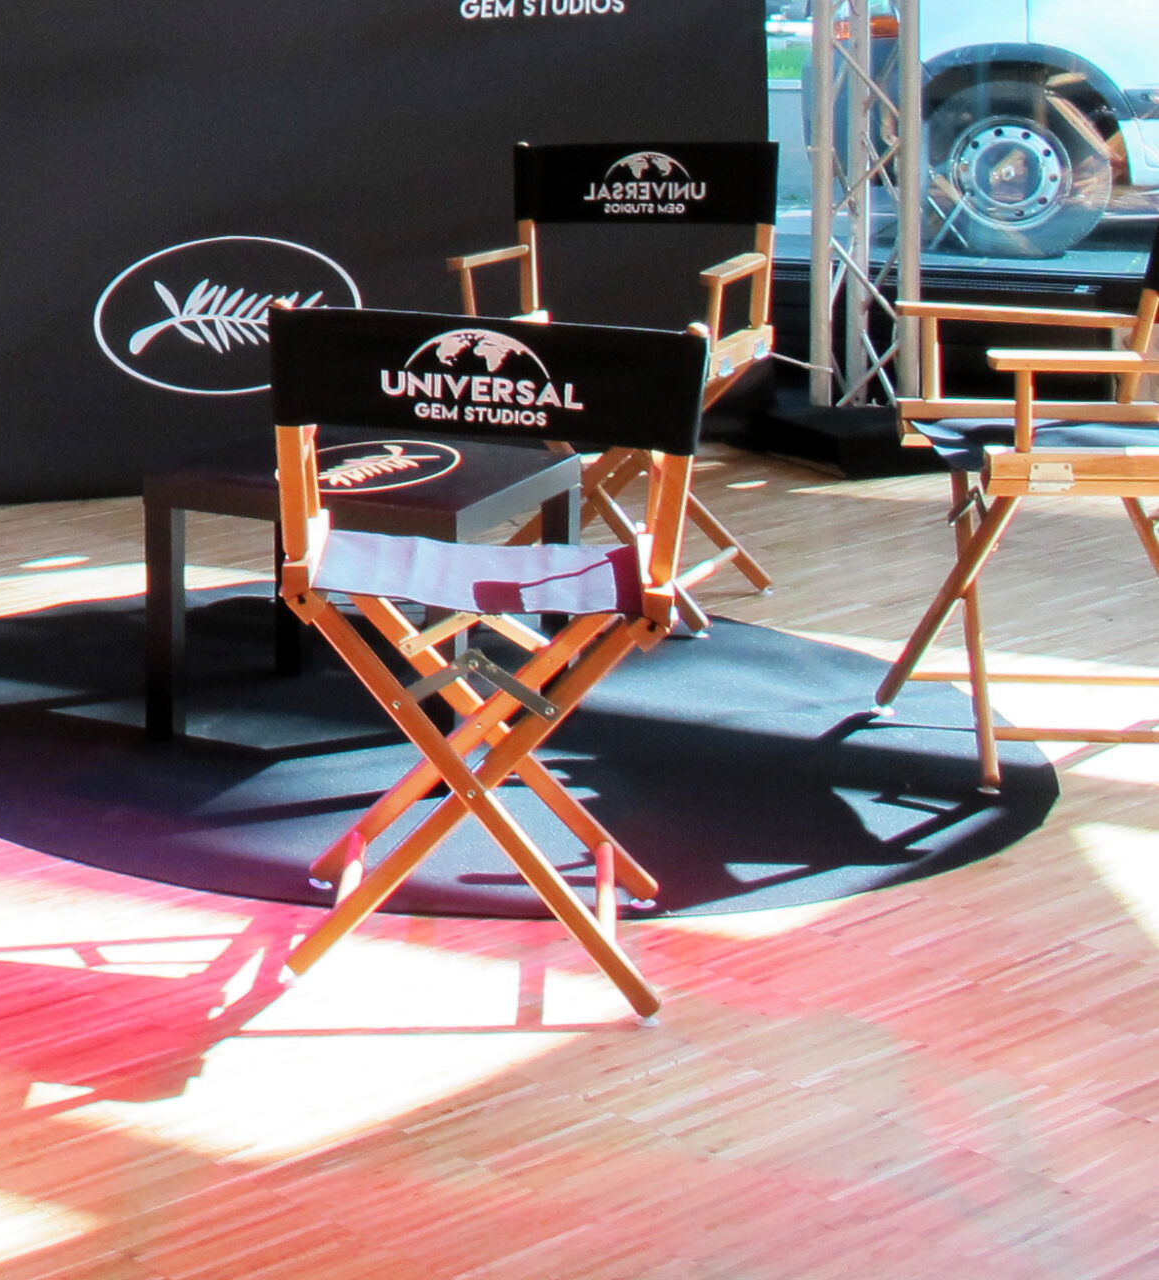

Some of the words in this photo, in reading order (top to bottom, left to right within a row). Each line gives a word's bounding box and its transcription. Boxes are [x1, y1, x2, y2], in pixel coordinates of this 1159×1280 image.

[380, 369, 584, 410] UNIVERSAL
[414, 402, 459, 421] GEM
[464, 406, 548, 427] STUDIOS
